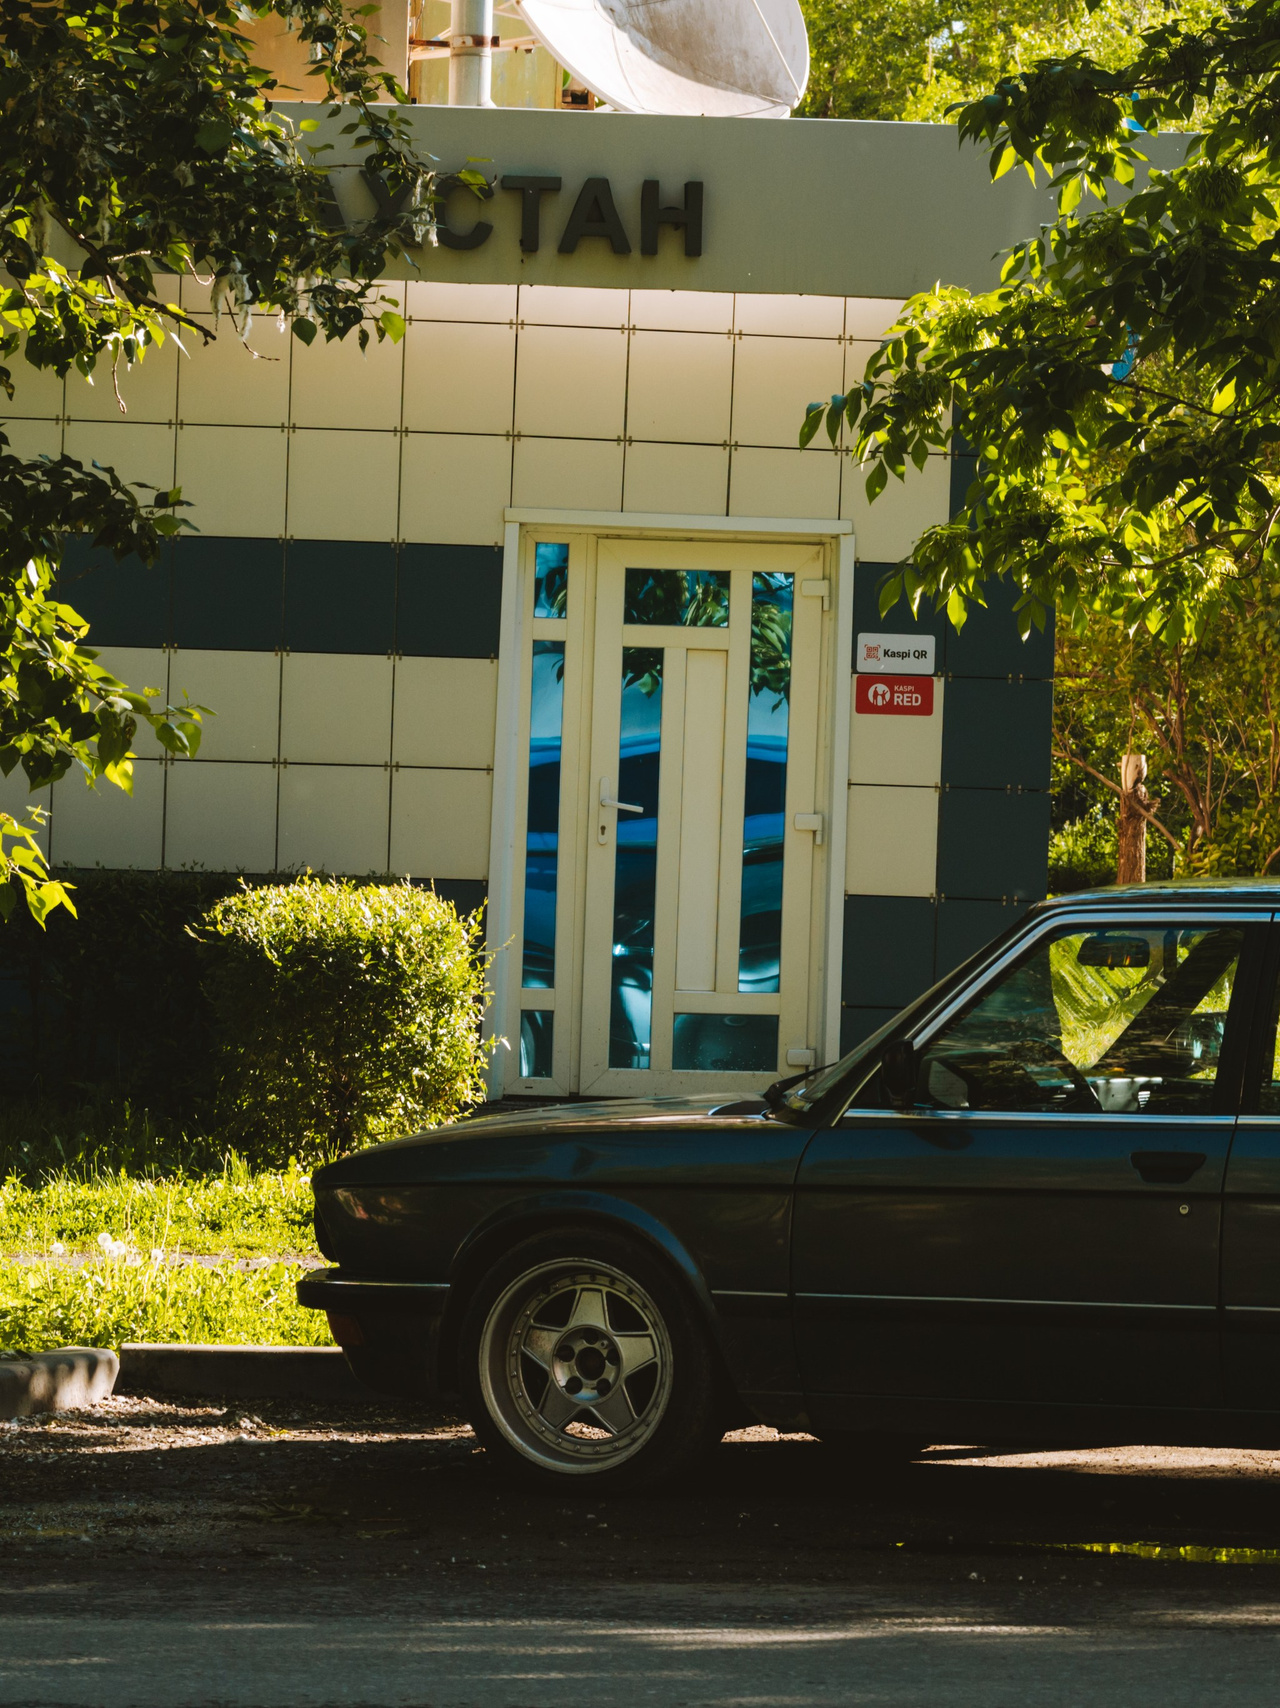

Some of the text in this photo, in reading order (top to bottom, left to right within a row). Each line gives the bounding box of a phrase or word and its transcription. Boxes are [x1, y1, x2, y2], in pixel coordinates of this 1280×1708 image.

[883, 648, 928, 660] Kaspi QR
[893, 693, 922, 706] RED
